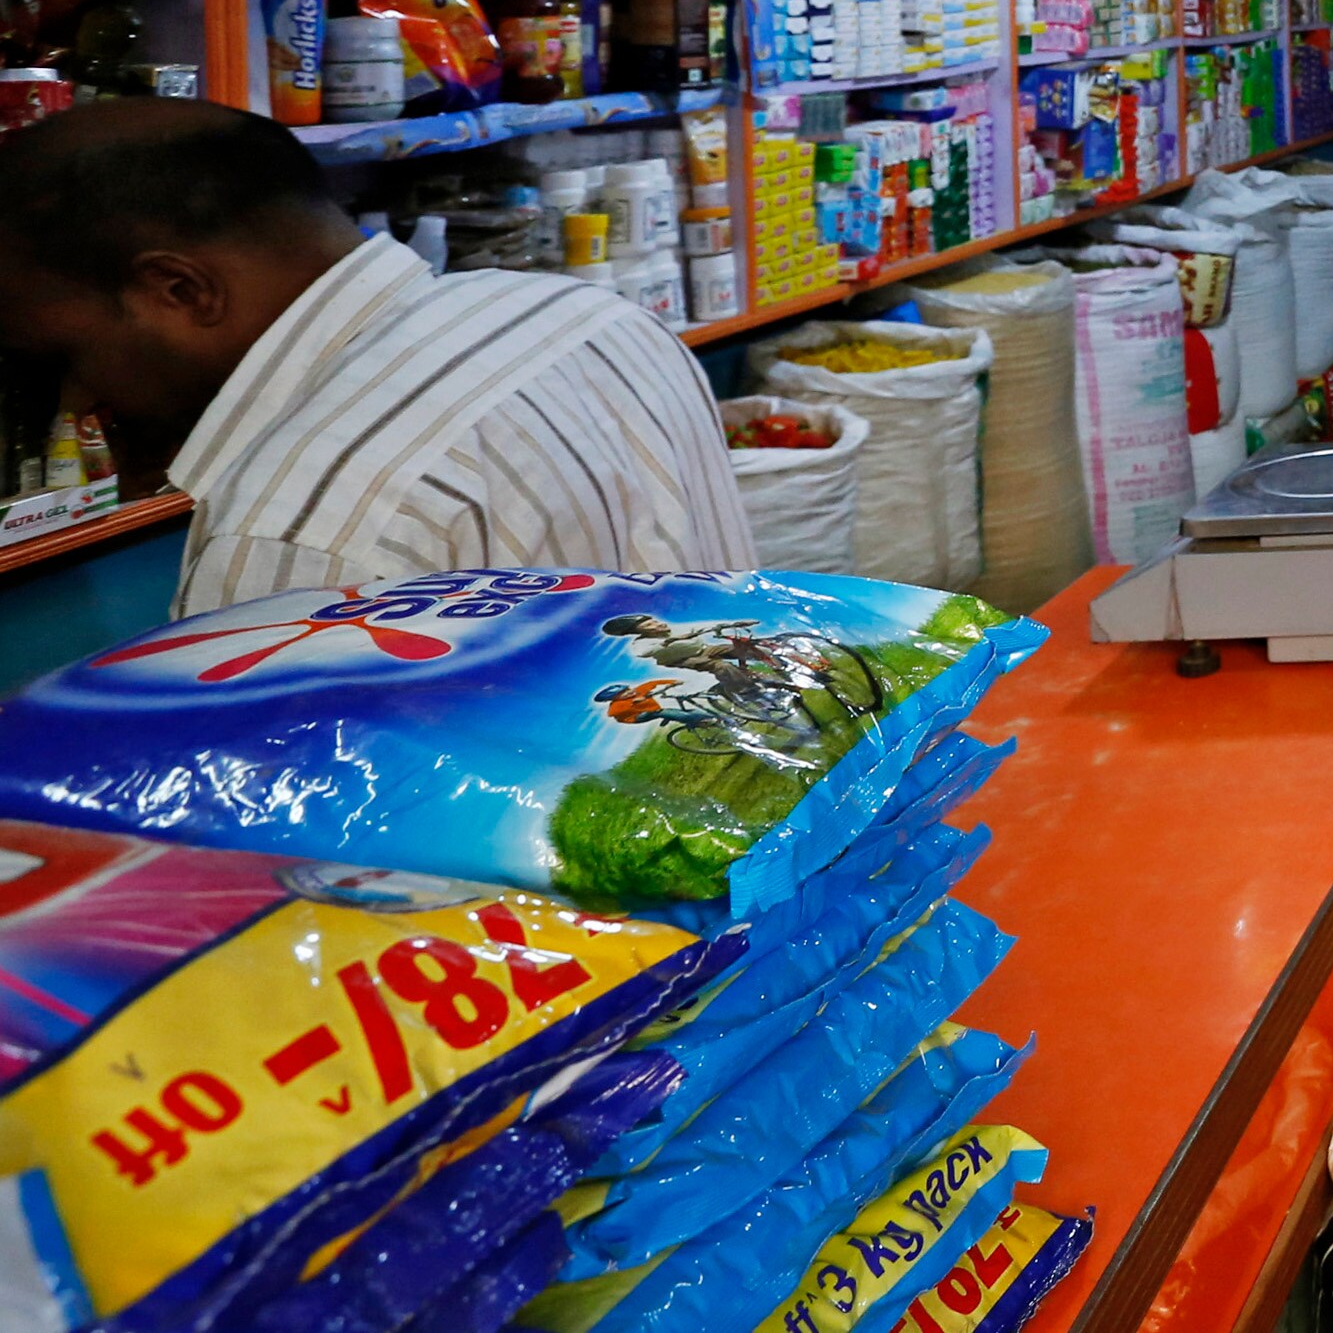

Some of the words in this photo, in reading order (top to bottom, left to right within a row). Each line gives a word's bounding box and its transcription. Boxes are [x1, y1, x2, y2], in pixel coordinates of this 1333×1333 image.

[262, 901, 593, 1107] 78/-
[90, 1071, 245, 1189] off
[817, 1265, 858, 1314] 3
[847, 1220, 924, 1279] kg
[903, 1136, 993, 1232] pack
